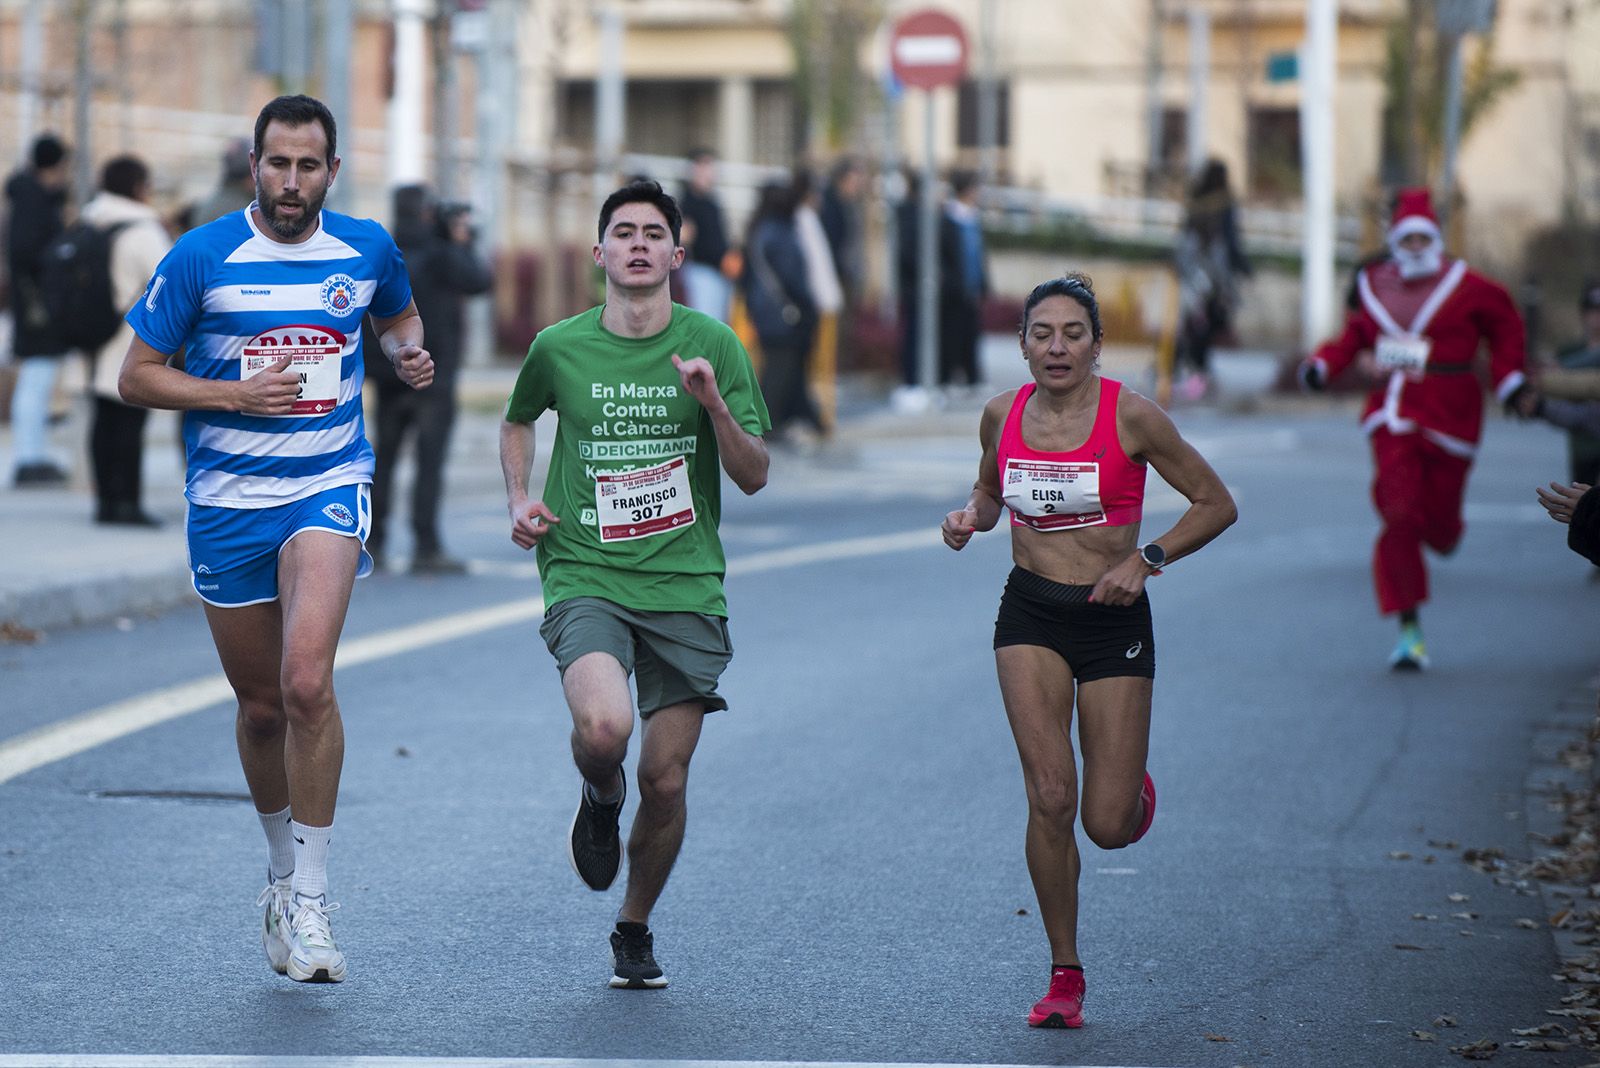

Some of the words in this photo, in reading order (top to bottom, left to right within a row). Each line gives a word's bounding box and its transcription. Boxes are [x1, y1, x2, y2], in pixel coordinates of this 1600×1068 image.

[591, 383, 615, 398] En
[620, 383, 678, 398] Marxa
[602, 402, 668, 417] Contra
[592, 421, 610, 436] el
[613, 420, 681, 436] Càncer
[597, 440, 695, 456] DEICHMANN
[612, 487, 677, 509] FRANCISCO
[1032, 489, 1065, 501] ELISA
[631, 504, 663, 522] 307
[1044, 504, 1056, 513] 2
